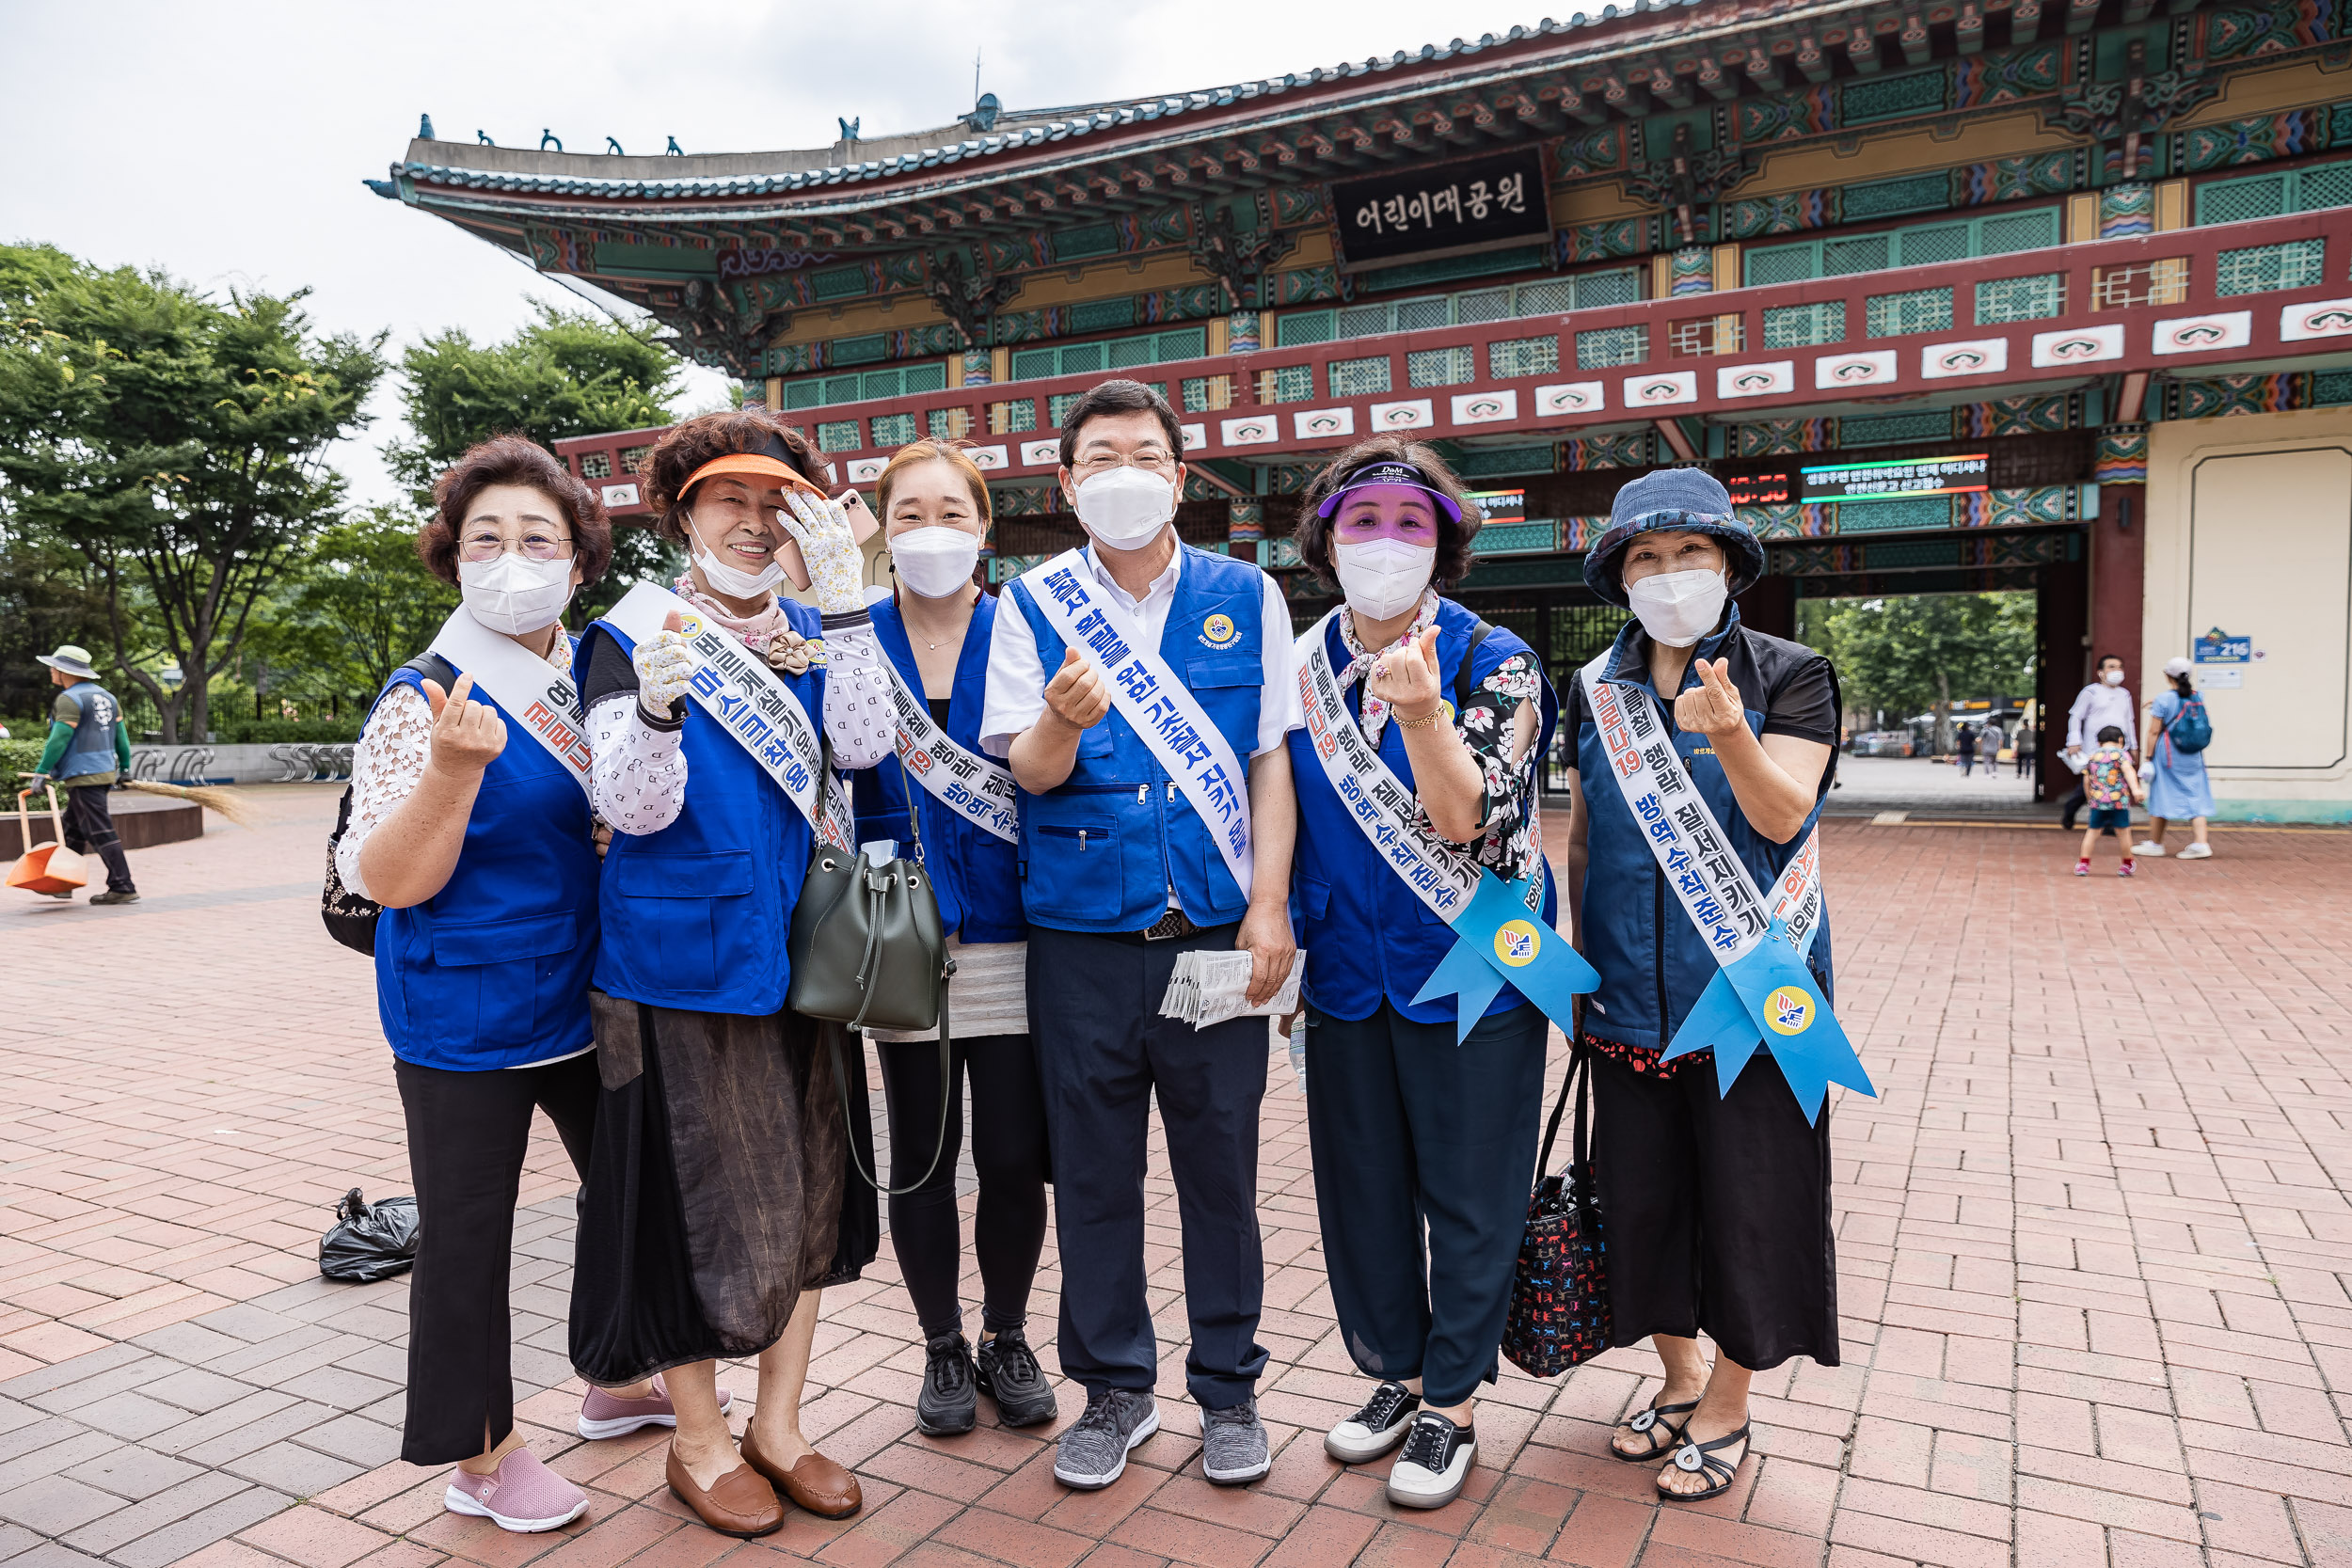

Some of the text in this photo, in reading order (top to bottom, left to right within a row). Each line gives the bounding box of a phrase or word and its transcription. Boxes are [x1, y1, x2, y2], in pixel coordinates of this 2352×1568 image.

[1357, 173, 1525, 233] 어린이대공원
[1899, 477, 1946, 492] 신고접수
[1940, 459, 1988, 475] 어디서나
[2219, 641, 2249, 657] 216
[523, 701, 592, 773] 코로나
[690, 666, 810, 794] 마스크착용
[1042, 566, 1248, 861] 법질서 확립을 위한 기초질서 지키기 운동
[1310, 644, 1343, 722] 여름철
[1336, 724, 1376, 777] 행락
[1592, 684, 1643, 778] 코로나19
[929, 739, 981, 780] 행락
[1643, 741, 1685, 797] 행락
